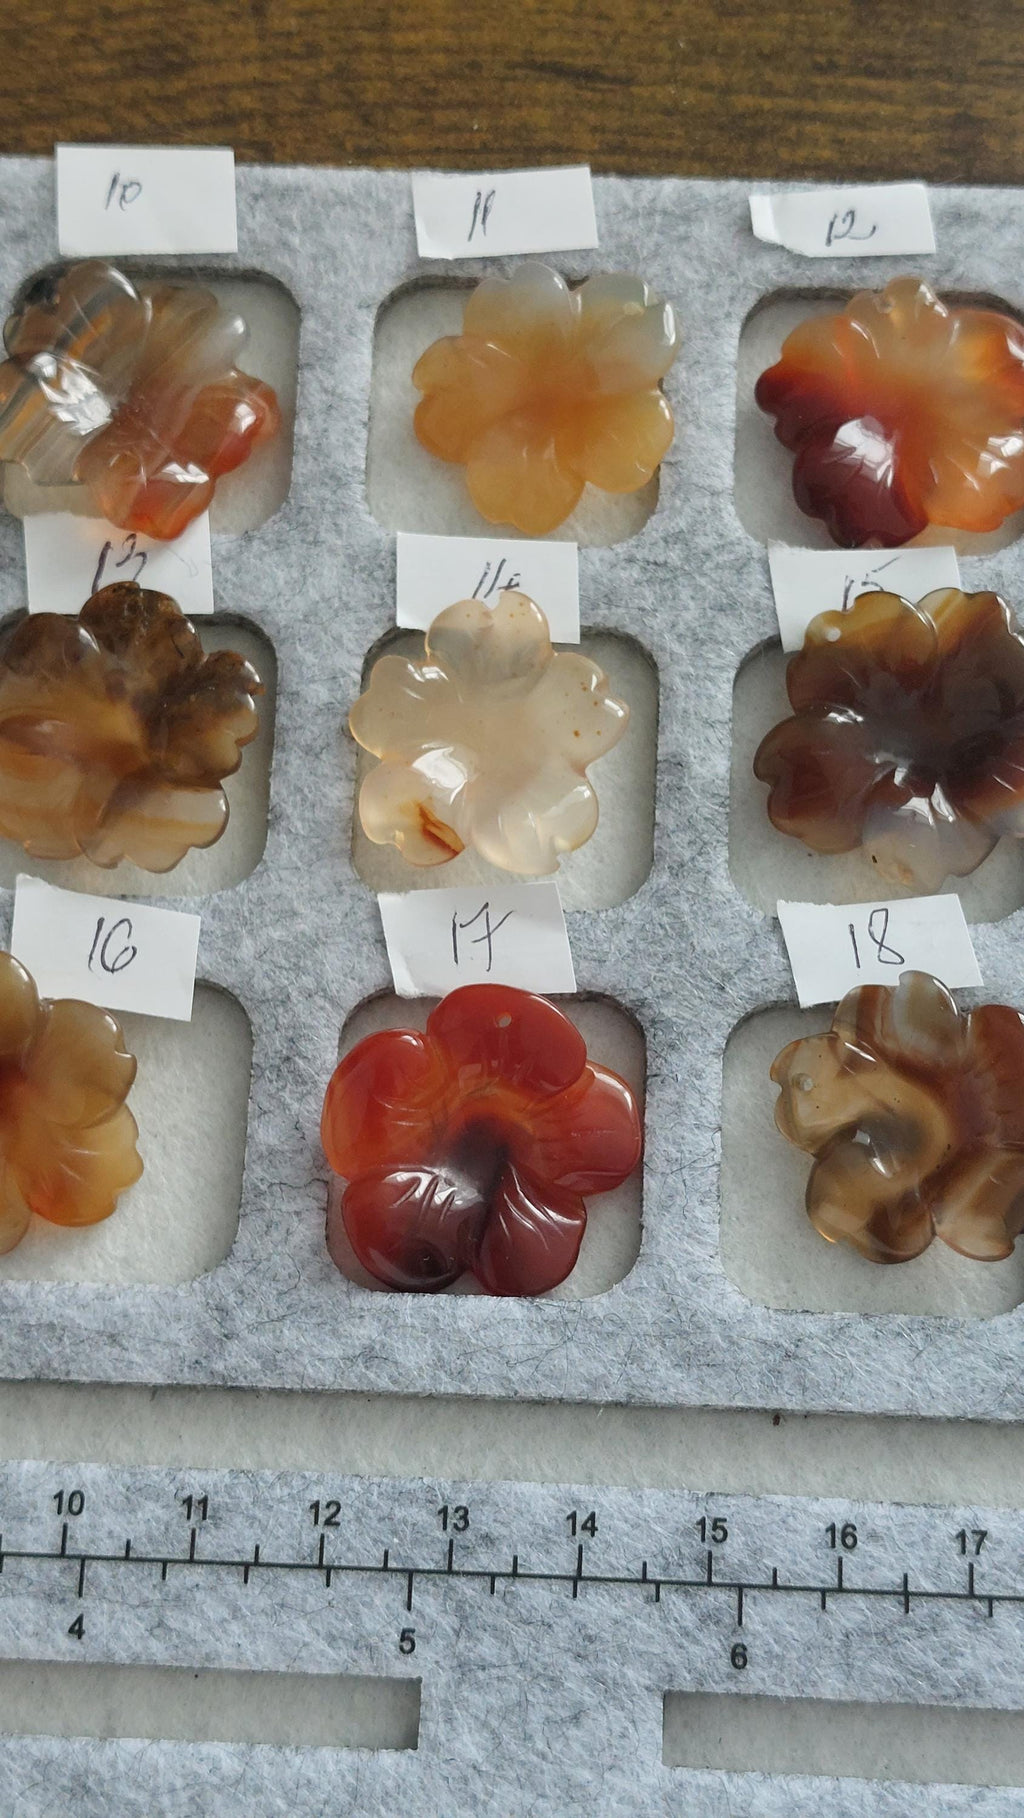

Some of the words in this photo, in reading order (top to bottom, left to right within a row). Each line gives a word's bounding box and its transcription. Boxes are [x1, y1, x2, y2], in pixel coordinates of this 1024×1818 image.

[104, 171, 142, 212] 10
[467, 188, 496, 242] 11
[825, 208, 877, 248] 12
[87, 917, 138, 973] 16
[451, 900, 514, 972] 17
[848, 906, 905, 969] 18
[53, 1489, 85, 1517] 10
[182, 1494, 209, 1521] 11
[309, 1500, 341, 1527] 12
[437, 1505, 470, 1532] 13
[566, 1510, 598, 1538] 14
[697, 1516, 729, 1544] 15
[825, 1522, 858, 1550] 16
[956, 1529, 988, 1556] 17
[68, 1613, 85, 1639] 4
[400, 1627, 416, 1654] 5
[730, 1643, 748, 1670] 6
